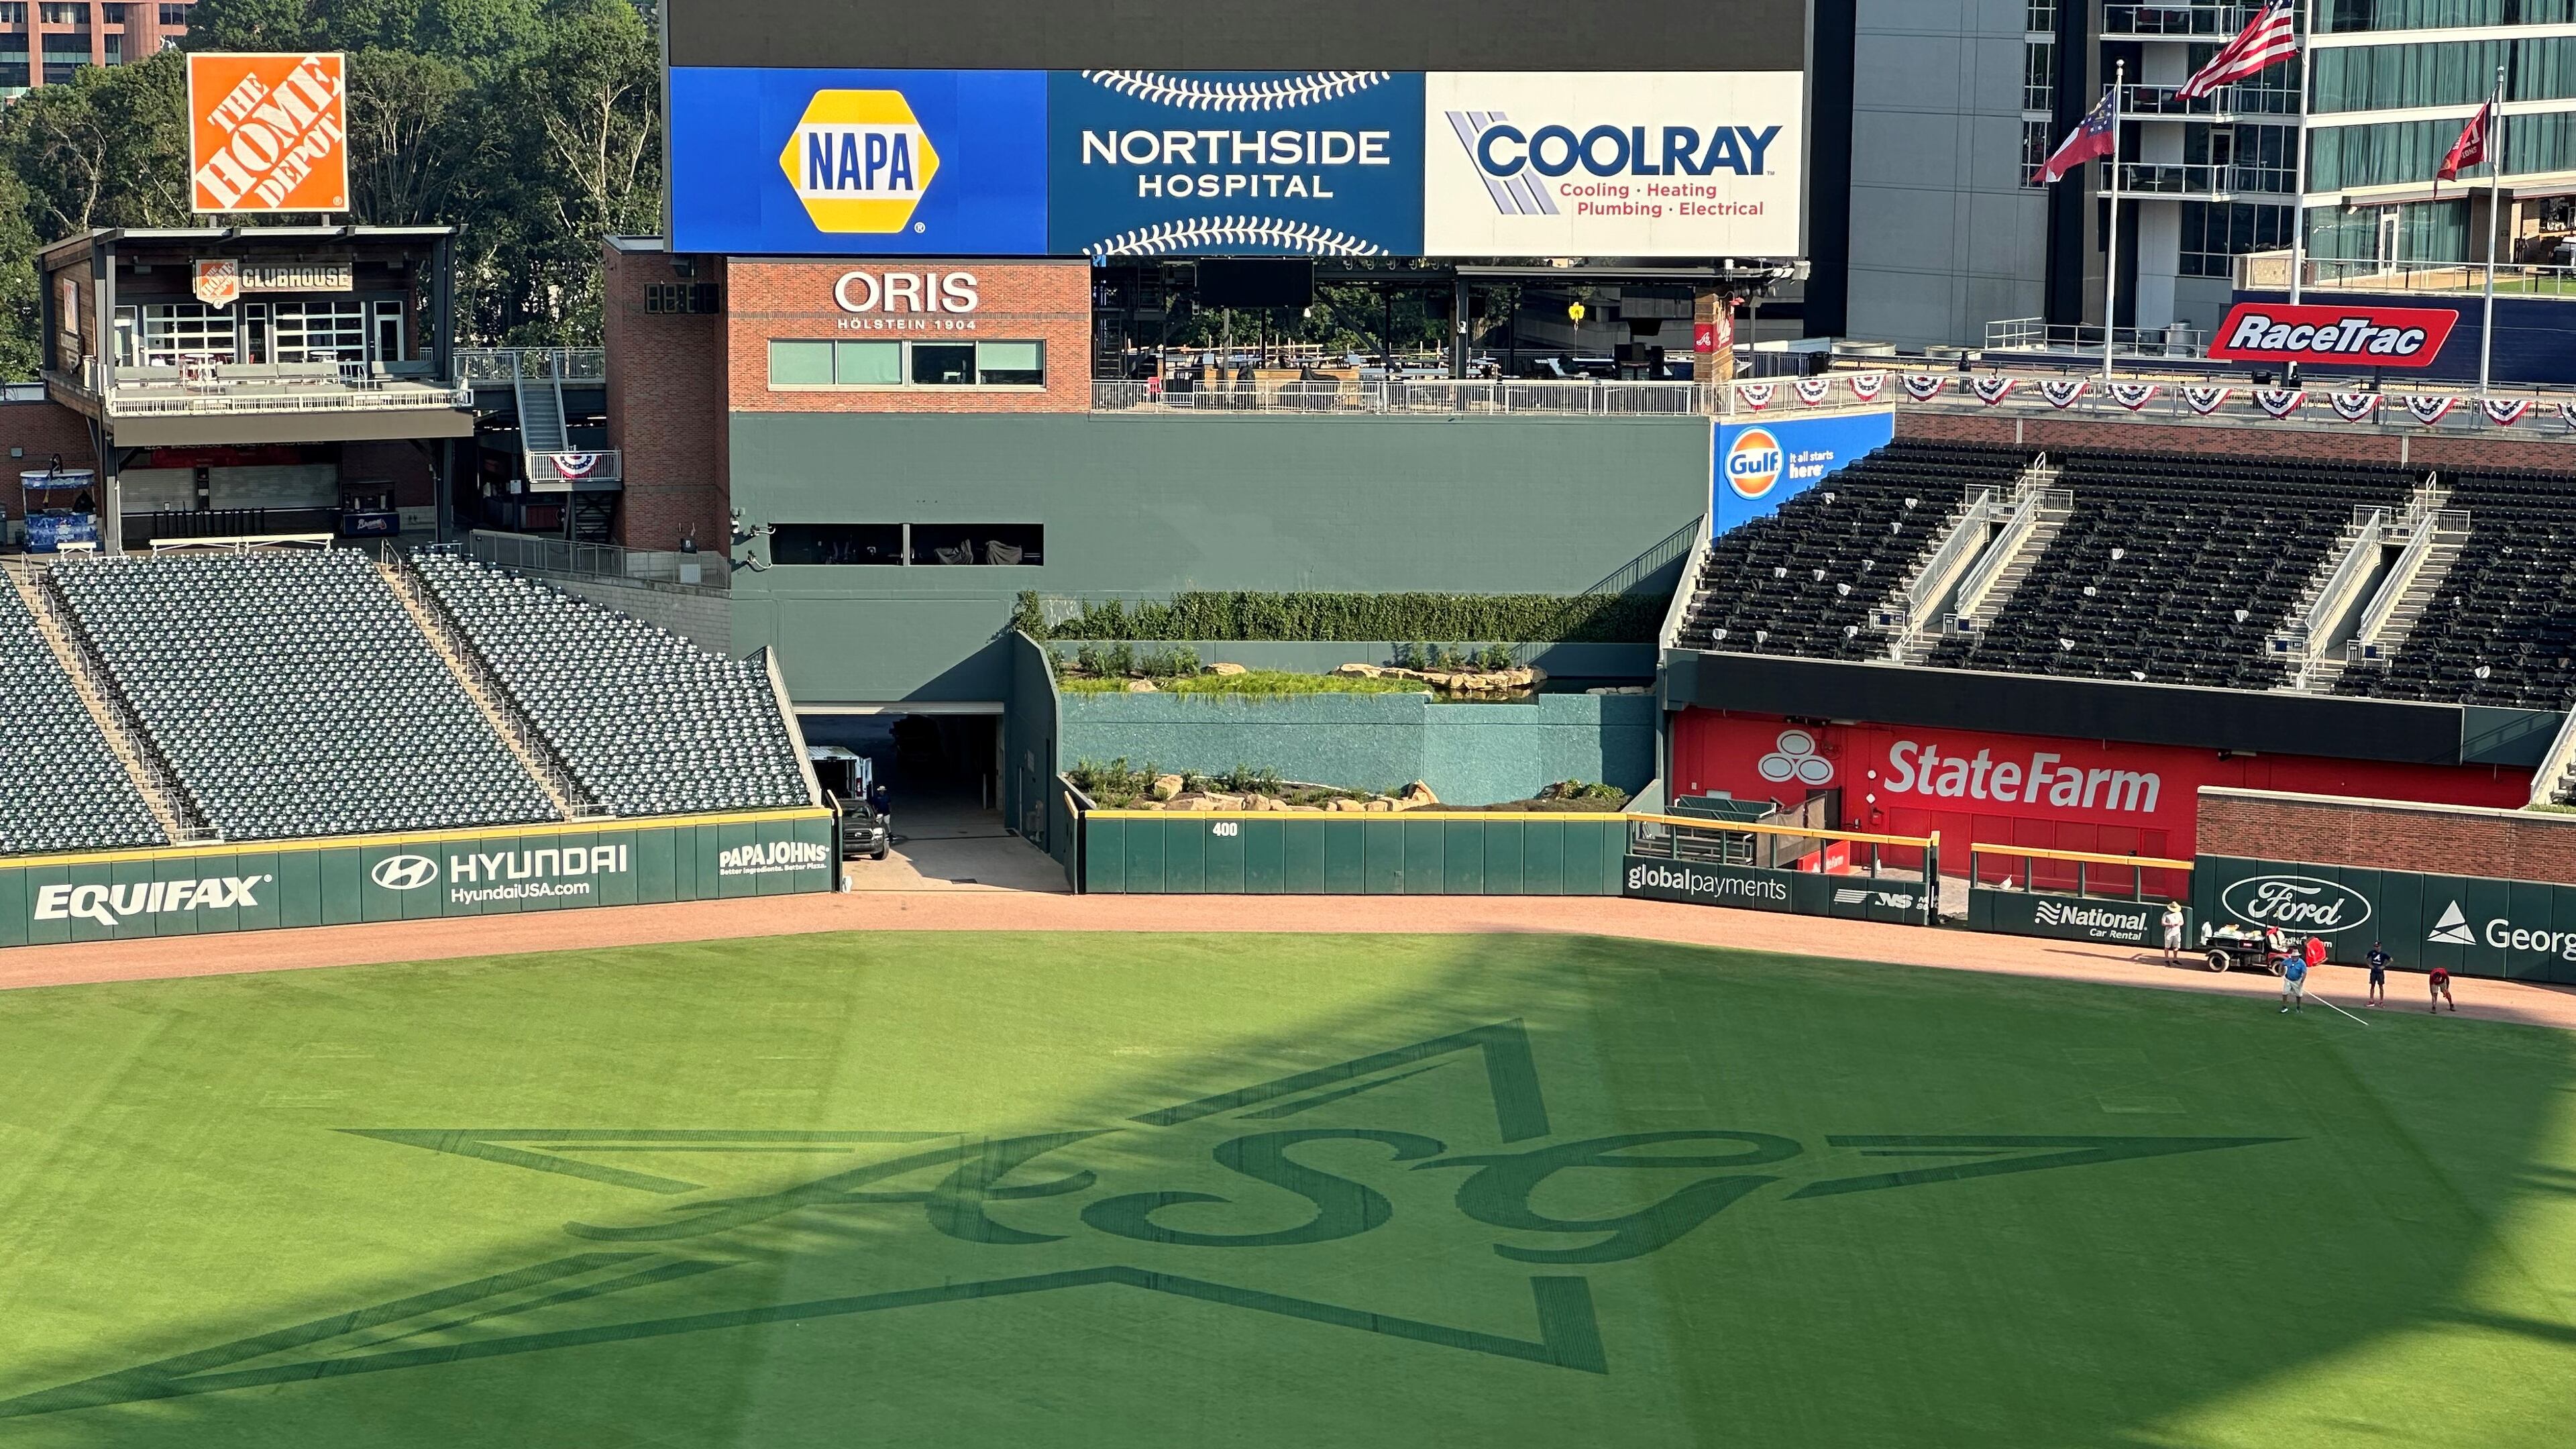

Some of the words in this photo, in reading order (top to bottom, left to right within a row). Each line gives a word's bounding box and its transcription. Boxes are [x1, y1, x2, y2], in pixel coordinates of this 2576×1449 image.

[207, 72, 269, 133] THE
[195, 56, 340, 209] HOME
[1081, 130, 1390, 165] NORTHSIDE
[1478, 125, 1783, 177] COOLRAY
[254, 112, 343, 209] DEPOT
[809, 132, 914, 191] NAPA
[1139, 174, 1334, 198] HOSPITAL
[1560, 183, 1629, 199] Cooling
[1647, 183, 1717, 199] Heating
[1578, 202, 1662, 218] Plumbing
[1679, 202, 1764, 215] Electrical
[241, 268, 348, 288] CLUBHOUSE
[834, 271, 978, 313] ORIS
[837, 317, 925, 329] HÖLSTEIN
[934, 320, 976, 329] 1904
[2229, 315, 2424, 354] RaceTrac
[1730, 451, 1778, 475] Gulf
[1790, 452, 1797, 463] It
[1798, 451, 1808, 462] all
[1810, 450, 1834, 462] starts
[1790, 464, 1822, 478] here
[1213, 822, 1238, 837] 400
[450, 845, 627, 883] HYUNDAI
[34, 875, 262, 925] EQUIFAX
[451, 881, 590, 904] HyundaiUSA.com
[2248, 881, 2345, 925] Ford
[2060, 906, 2147, 930] National
[2090, 928, 2106, 937] Car
[2110, 930, 2142, 941] Rental
